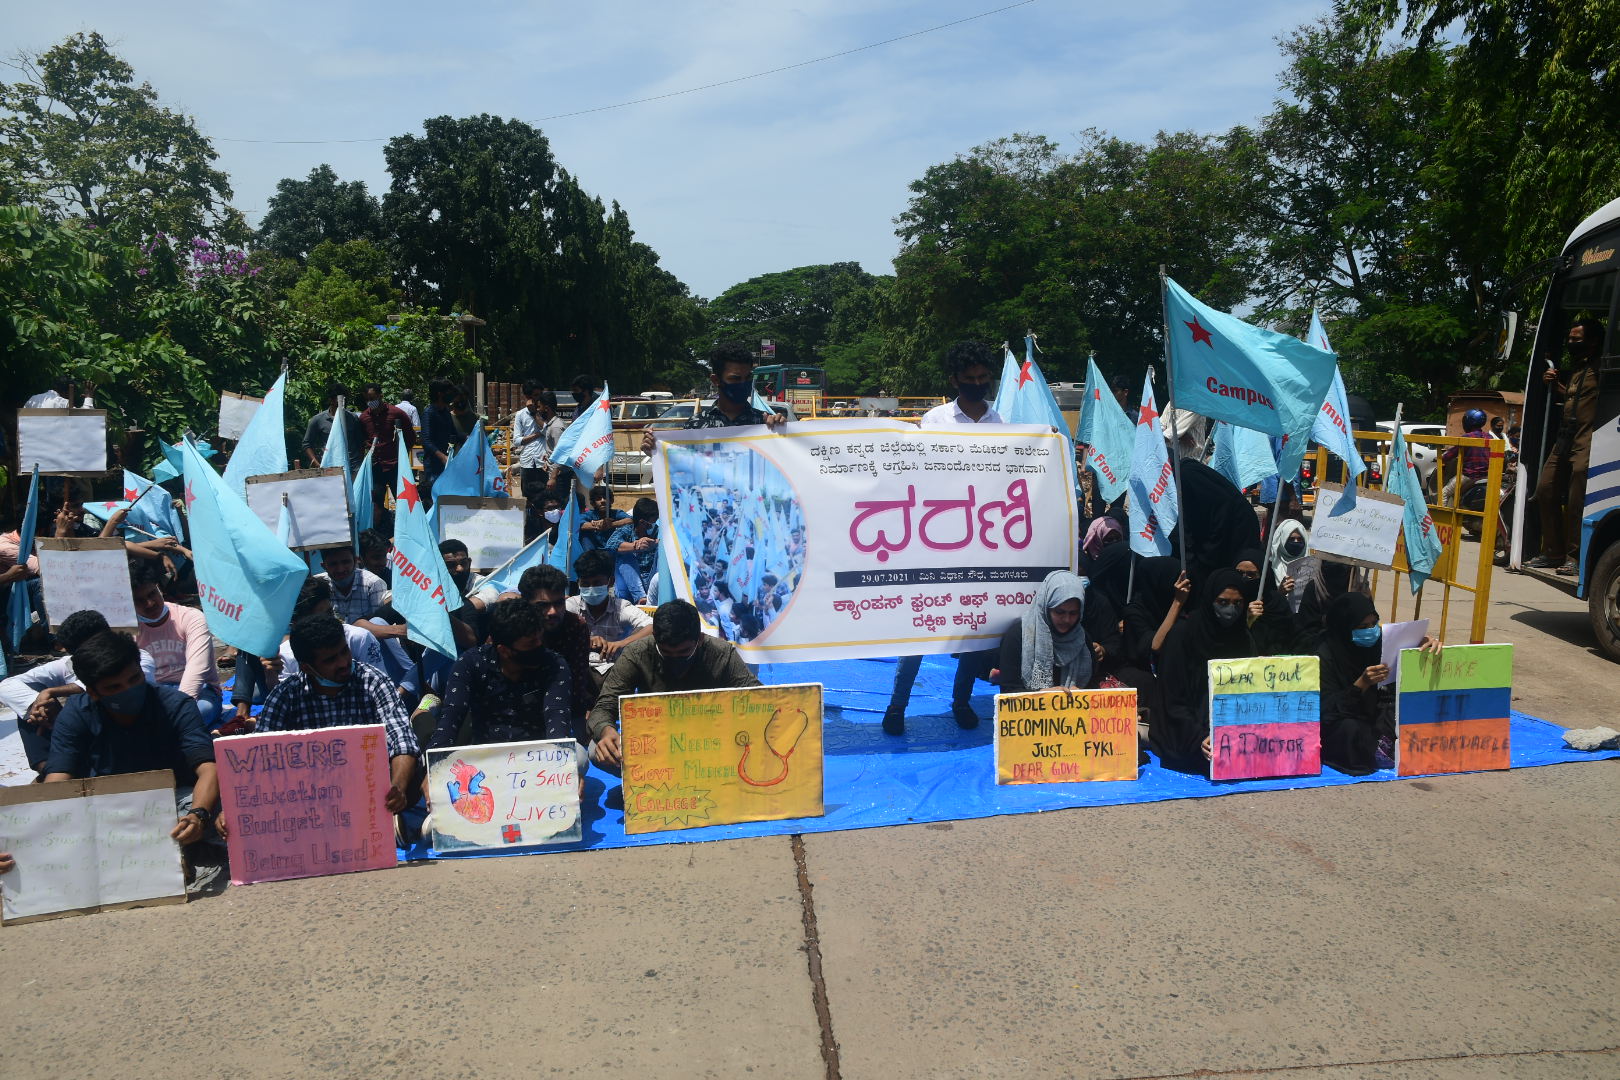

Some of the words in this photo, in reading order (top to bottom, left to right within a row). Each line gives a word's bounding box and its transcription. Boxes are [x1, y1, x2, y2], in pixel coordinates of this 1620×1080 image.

[1206, 376, 1274, 410] Campus
[810, 445, 840, 461] ದಕ್ಷಿಣ
[846, 443, 874, 459] ಕನ್ನಡ
[880, 441, 925, 457] ಜಿಲ್ಲೆಯಲ್ಲಿ
[930, 443, 964, 454] ಸರ್ಕಾರಿ
[969, 443, 1008, 455] ಮೆಡಿಕಲ್
[1014, 445, 1050, 456] ಕಾಲೇಜು
[819, 460, 878, 478] ನಿರ್ಮಾಣಕ್ಕೆ
[883, 460, 919, 475] ಆಗ್ರಹಿಸಿ
[924, 460, 1001, 472] ಜನಾಂದೋಲನದ
[1005, 463, 1046, 474] ಭಾಗವಾಗಿ
[1093, 453, 1117, 485] Front
[850, 478, 1033, 562] ಧರಣಿ
[861, 573, 909, 584] 29.07.2021
[918, 572, 936, 581] ಮಿನಿ
[939, 571, 964, 581] ವಿಧಾನ
[990, 571, 1029, 580] ಮಂಗಳೂರು
[207, 585, 244, 621] Front
[833, 594, 903, 620] ಕ್ಯಾಂಪಸ್
[960, 591, 989, 607] ಆಫ್
[913, 614, 946, 632] ದಕ್ಷಿಣ
[953, 611, 987, 630] ಕನ್ನಡ
[999, 697, 1046, 713] MIDDLE
[1051, 694, 1090, 711] CLASS
[1090, 694, 1137, 710] STUDENTS
[1215, 698, 1228, 716] I
[1436, 694, 1470, 716] IT
[1075, 717, 1087, 734] A
[1090, 717, 1133, 736] DOCTOR
[630, 736, 657, 756] DK
[1220, 733, 1231, 756] A
[224, 739, 348, 774] WHERE
[507, 751, 516, 764] A
[526, 750, 571, 767] STUDY
[535, 770, 573, 787] SAVE
[1013, 761, 1043, 779] DEAR
[234, 780, 343, 808] Education
[331, 804, 351, 828] Is
[506, 797, 567, 821] LIVES
[244, 849, 305, 876] Being
[311, 839, 369, 865] Used
